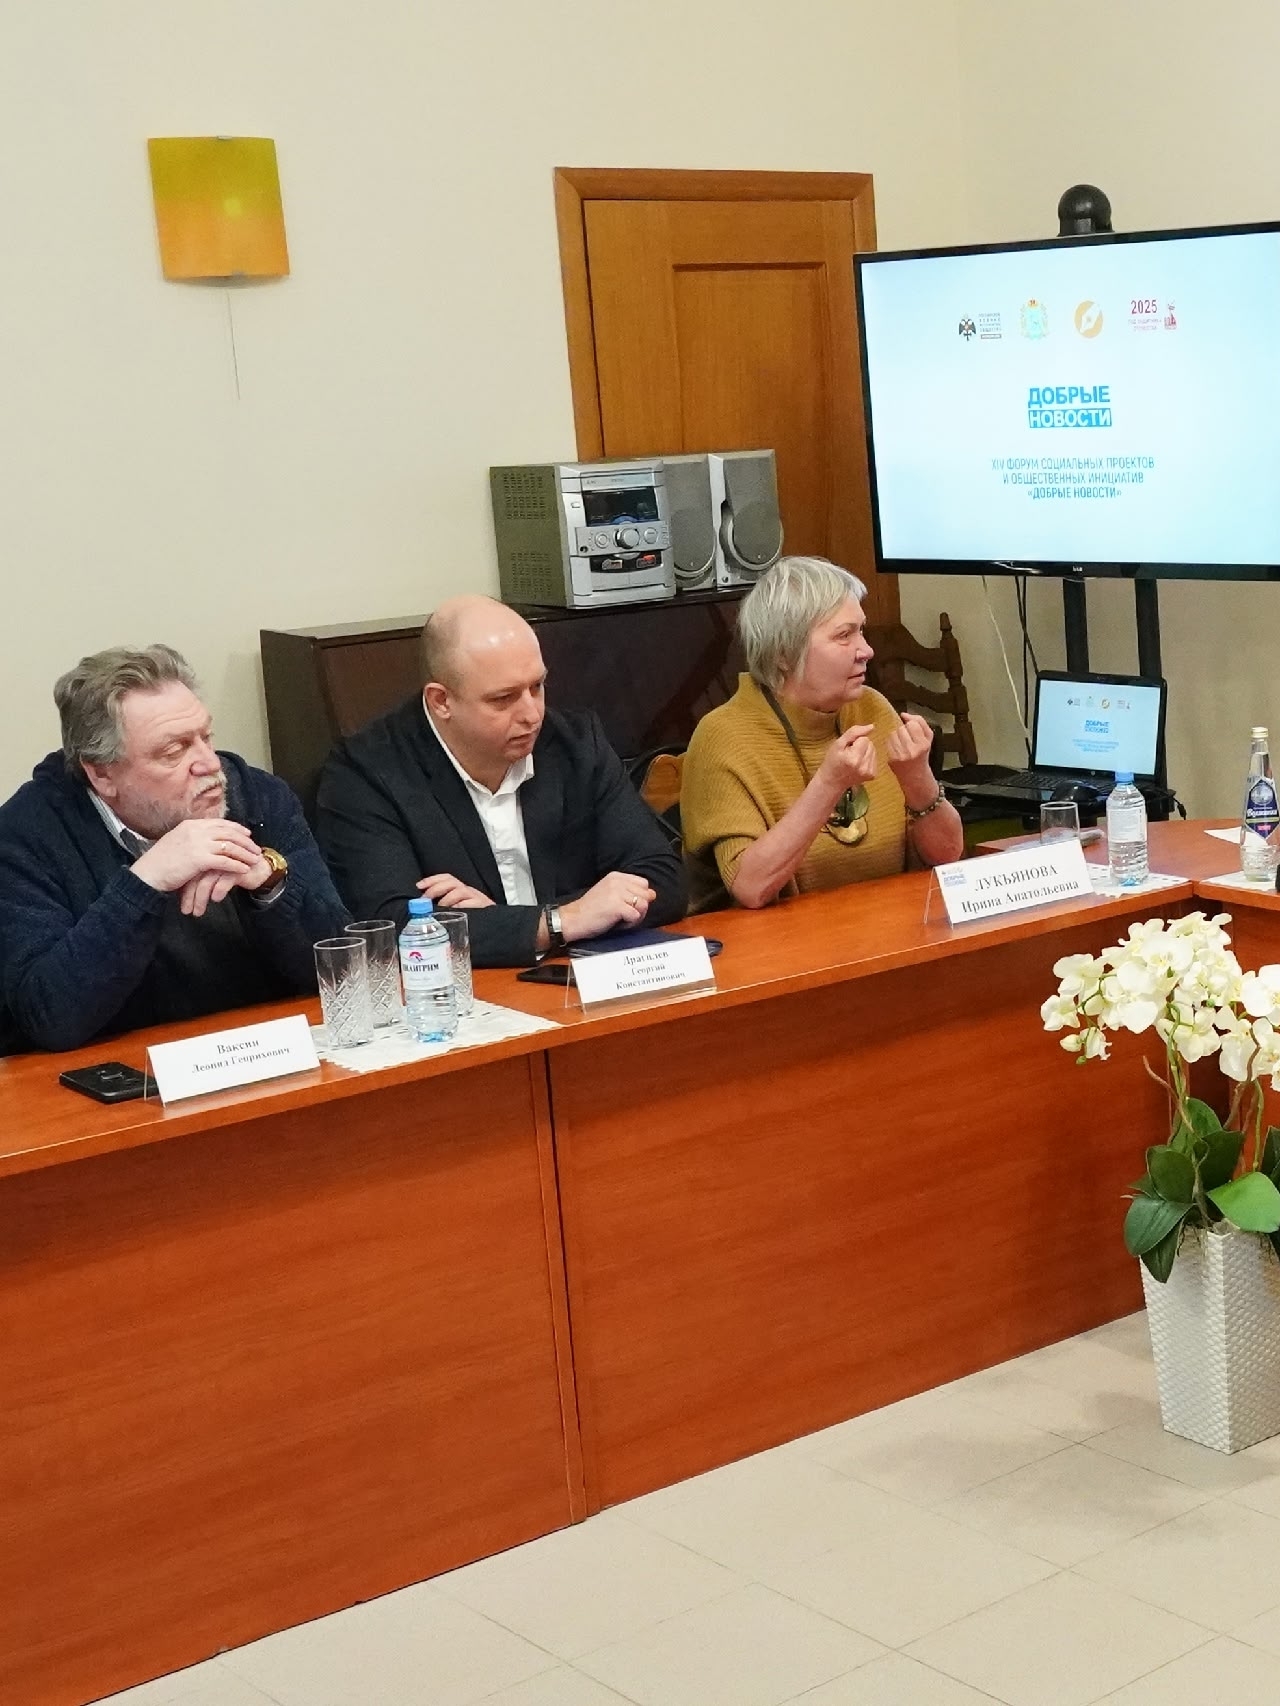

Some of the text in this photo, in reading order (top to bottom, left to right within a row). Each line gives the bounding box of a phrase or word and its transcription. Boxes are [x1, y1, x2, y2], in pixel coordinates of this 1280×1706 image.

[1131, 299, 1158, 314] 2025
[1028, 386, 1111, 408] ДОБРЫЕ
[1029, 409, 1111, 428] НОВОСТИ
[1007, 457, 1039, 470] ФОРУМ
[1041, 457, 1103, 471] СОЦИАЛЬНЫХ
[1106, 456, 1155, 469] ПРОЕКТОВ
[1011, 472, 1085, 485] ОБЩЕСТВЕННЫХ
[1088, 471, 1144, 485] ИНИЦИАТИВ
[974, 864, 1059, 892] ЛУКЬЯНОВА
[961, 880, 1080, 915] Ирина Анатольевна
[217, 1039, 259, 1055] Ваксин
[231, 1047, 290, 1065] Генрихович
